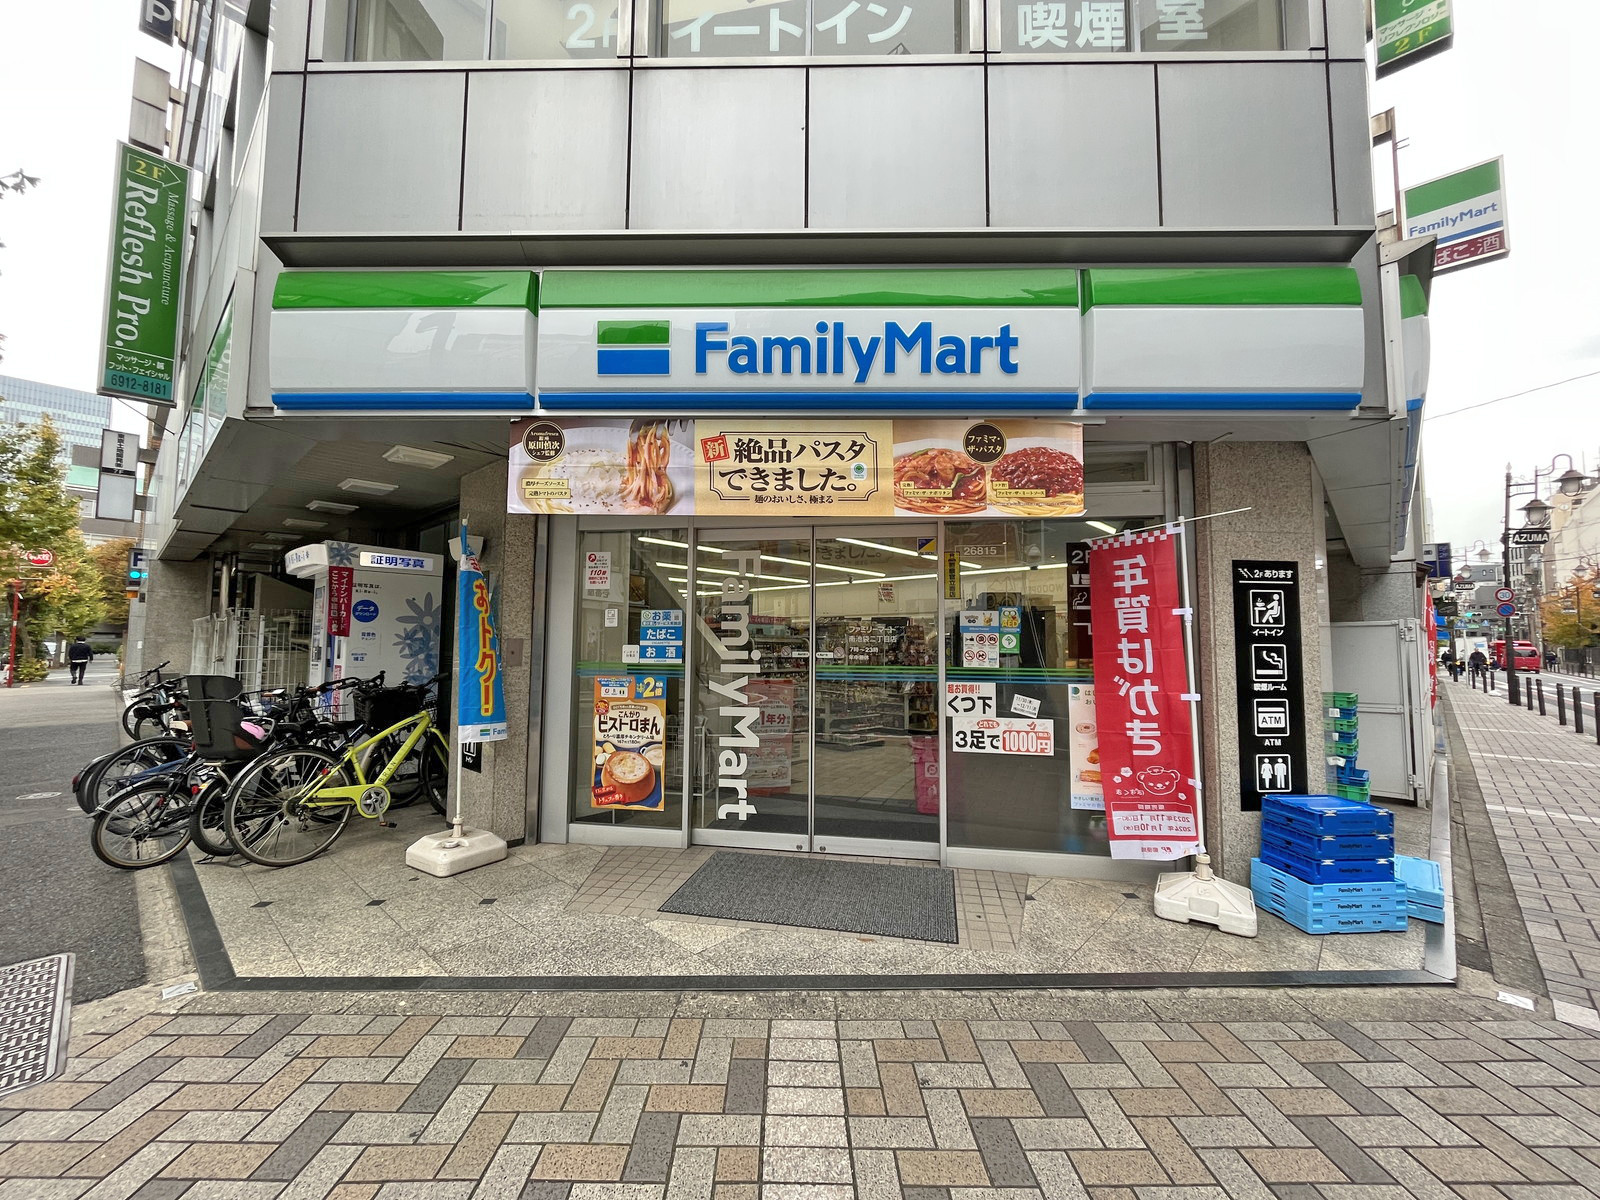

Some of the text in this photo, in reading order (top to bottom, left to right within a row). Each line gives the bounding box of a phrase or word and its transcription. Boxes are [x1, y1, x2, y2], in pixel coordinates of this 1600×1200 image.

[145, 0, 172, 23] P
[670, 2, 913, 52] イートイン
[1017, 0, 1208, 49] 喫煙室
[134, 159, 165, 180] 2F
[1409, 202, 1498, 237] FamilyMart
[160, 191, 179, 306] Massage & Acupuncture
[1434, 234, 1501, 266] ばこ・酒
[114, 177, 159, 347] Reflesh Pro.
[695, 320, 1019, 384] FamilyMart
[111, 374, 166, 396] 6912-8181
[704, 438, 727, 460] 新
[734, 438, 866, 464] 絶品パスタ
[718, 467, 857, 492] できました。
[1513, 532, 1549, 542] AZUMA
[371, 555, 425, 569] 証明写真
[963, 547, 997, 556] 26815
[652, 611, 671, 621] お薬
[1002, 619, 1019, 628] AED
[646, 629, 676, 640] たばこ
[849, 625, 897, 634] ファミリーマート
[646, 647, 676, 658] お酒
[708, 550, 761, 821] FamilyMart
[947, 684, 981, 694] 超お買得!!
[947, 695, 993, 714] くつ下
[598, 714, 660, 735] ビストロまん
[760, 711, 786, 725] 1年分
[1261, 715, 1282, 725] ATM
[492, 727, 507, 736] Fam
[955, 730, 1000, 750] 3足で
[1003, 731, 1051, 753] 1000円
[1264, 738, 1282, 747] ATM
